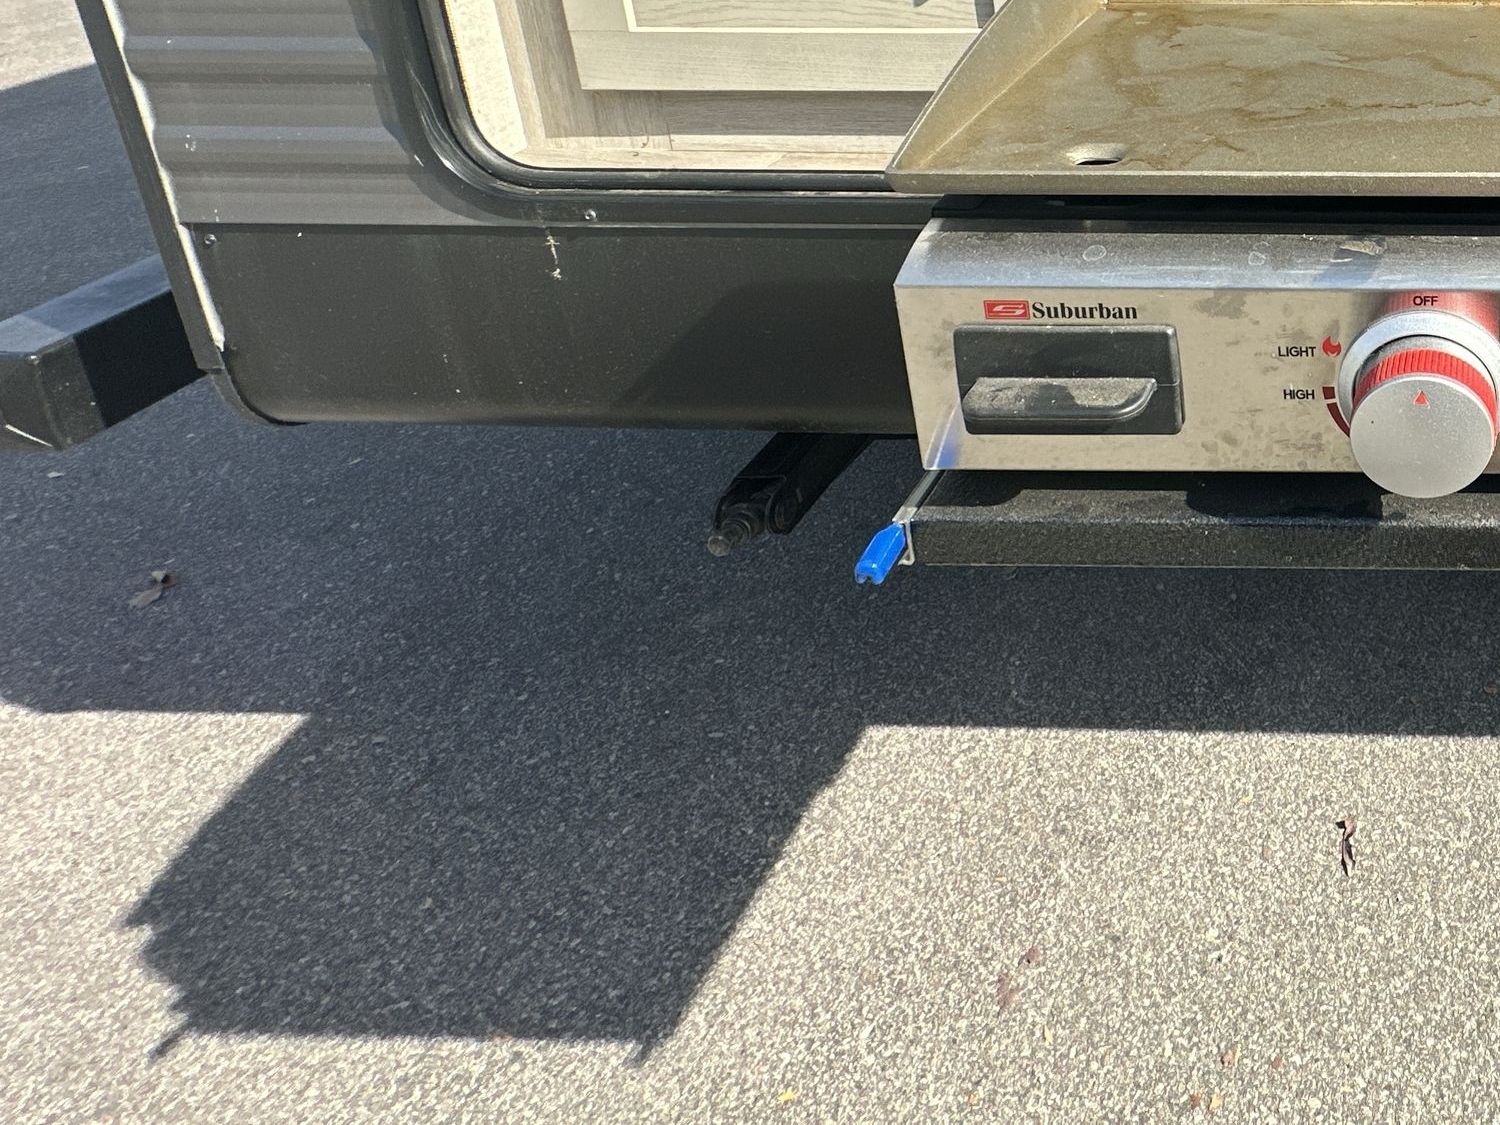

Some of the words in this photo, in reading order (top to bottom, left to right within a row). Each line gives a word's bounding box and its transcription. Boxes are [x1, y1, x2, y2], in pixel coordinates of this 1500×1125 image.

[1413, 296, 1438, 306] OFF
[1032, 302, 1138, 319] Suburban
[1278, 346, 1316, 358] LIGHT
[1283, 389, 1315, 400] HIGH
